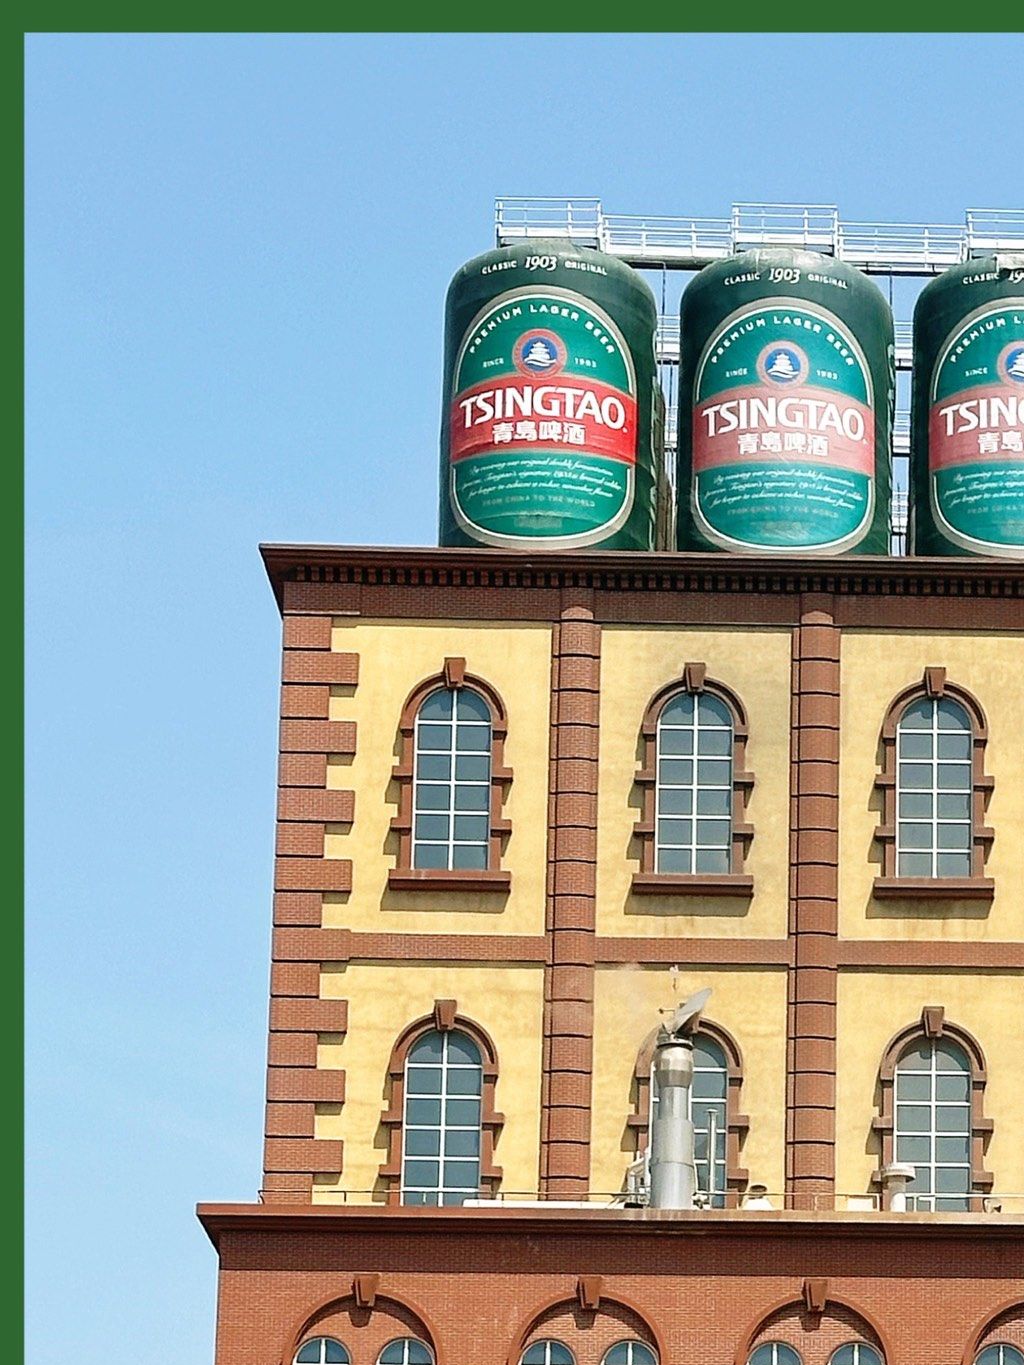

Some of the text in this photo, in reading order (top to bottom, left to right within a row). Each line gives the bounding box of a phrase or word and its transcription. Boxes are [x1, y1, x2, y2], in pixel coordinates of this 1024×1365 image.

[482, 256, 607, 275] CLASSIC 1903 ORIGINAL
[724, 268, 848, 289] CLASSIC 1903 ORIGINAL
[963, 272, 1000, 285] CLASSIC
[469, 304, 615, 353] PREMIUM LAGER BEER
[711, 316, 854, 366] PREMIUM LAGER BEER
[950, 318, 1006, 363] PREMIUM
[459, 386, 626, 430] TSINGTAO
[701, 397, 866, 441] TSINGTAO
